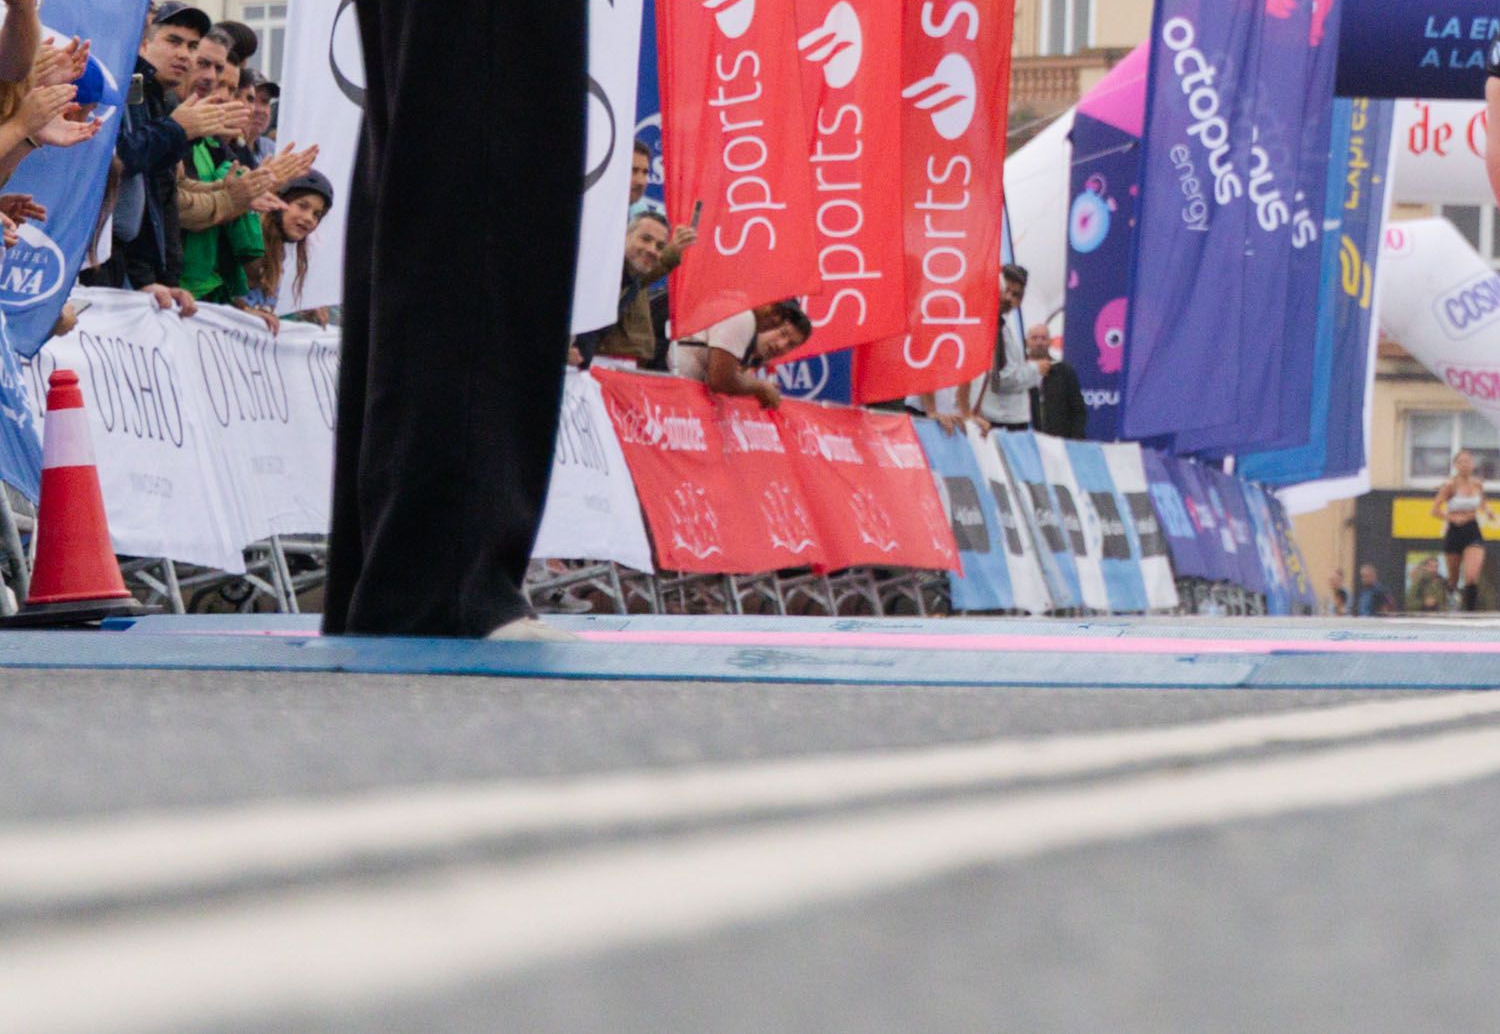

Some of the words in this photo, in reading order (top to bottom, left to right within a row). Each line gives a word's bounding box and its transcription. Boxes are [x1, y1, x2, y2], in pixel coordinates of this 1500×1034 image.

[1422, 49, 1441, 68] A
[1424, 17, 1461, 39] LA
[709, 49, 787, 257] Sports
[1162, 17, 1244, 206] octopus
[1170, 144, 1209, 232] energy
[801, 103, 882, 329] Sports
[904, 154, 981, 370] Sports
[80, 329, 183, 448] OYSHO
